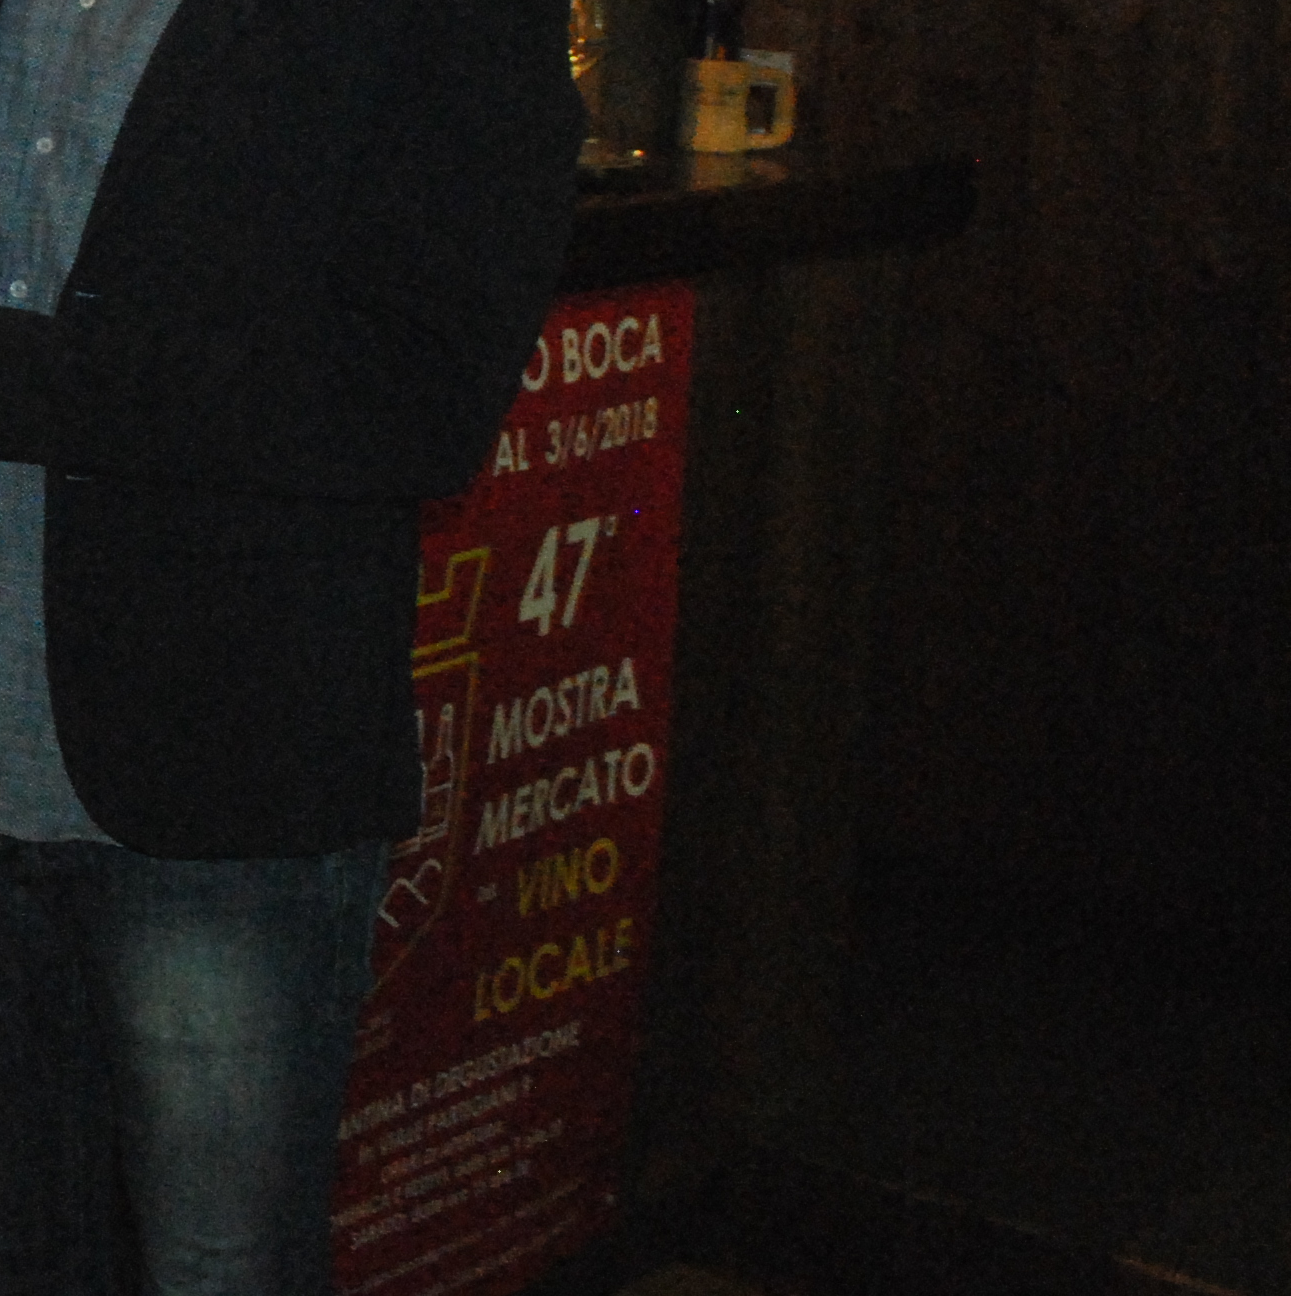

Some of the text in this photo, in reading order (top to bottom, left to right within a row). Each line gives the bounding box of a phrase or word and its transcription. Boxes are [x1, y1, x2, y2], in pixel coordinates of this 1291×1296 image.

[561, 313, 666, 384] BOCA
[492, 396, 659, 478] AL 3/6/2018
[488, 656, 643, 765] MOSTRA
[472, 742, 656, 856] MERCATO
[517, 836, 621, 917] VINO
[473, 917, 634, 1022] LOCALE
